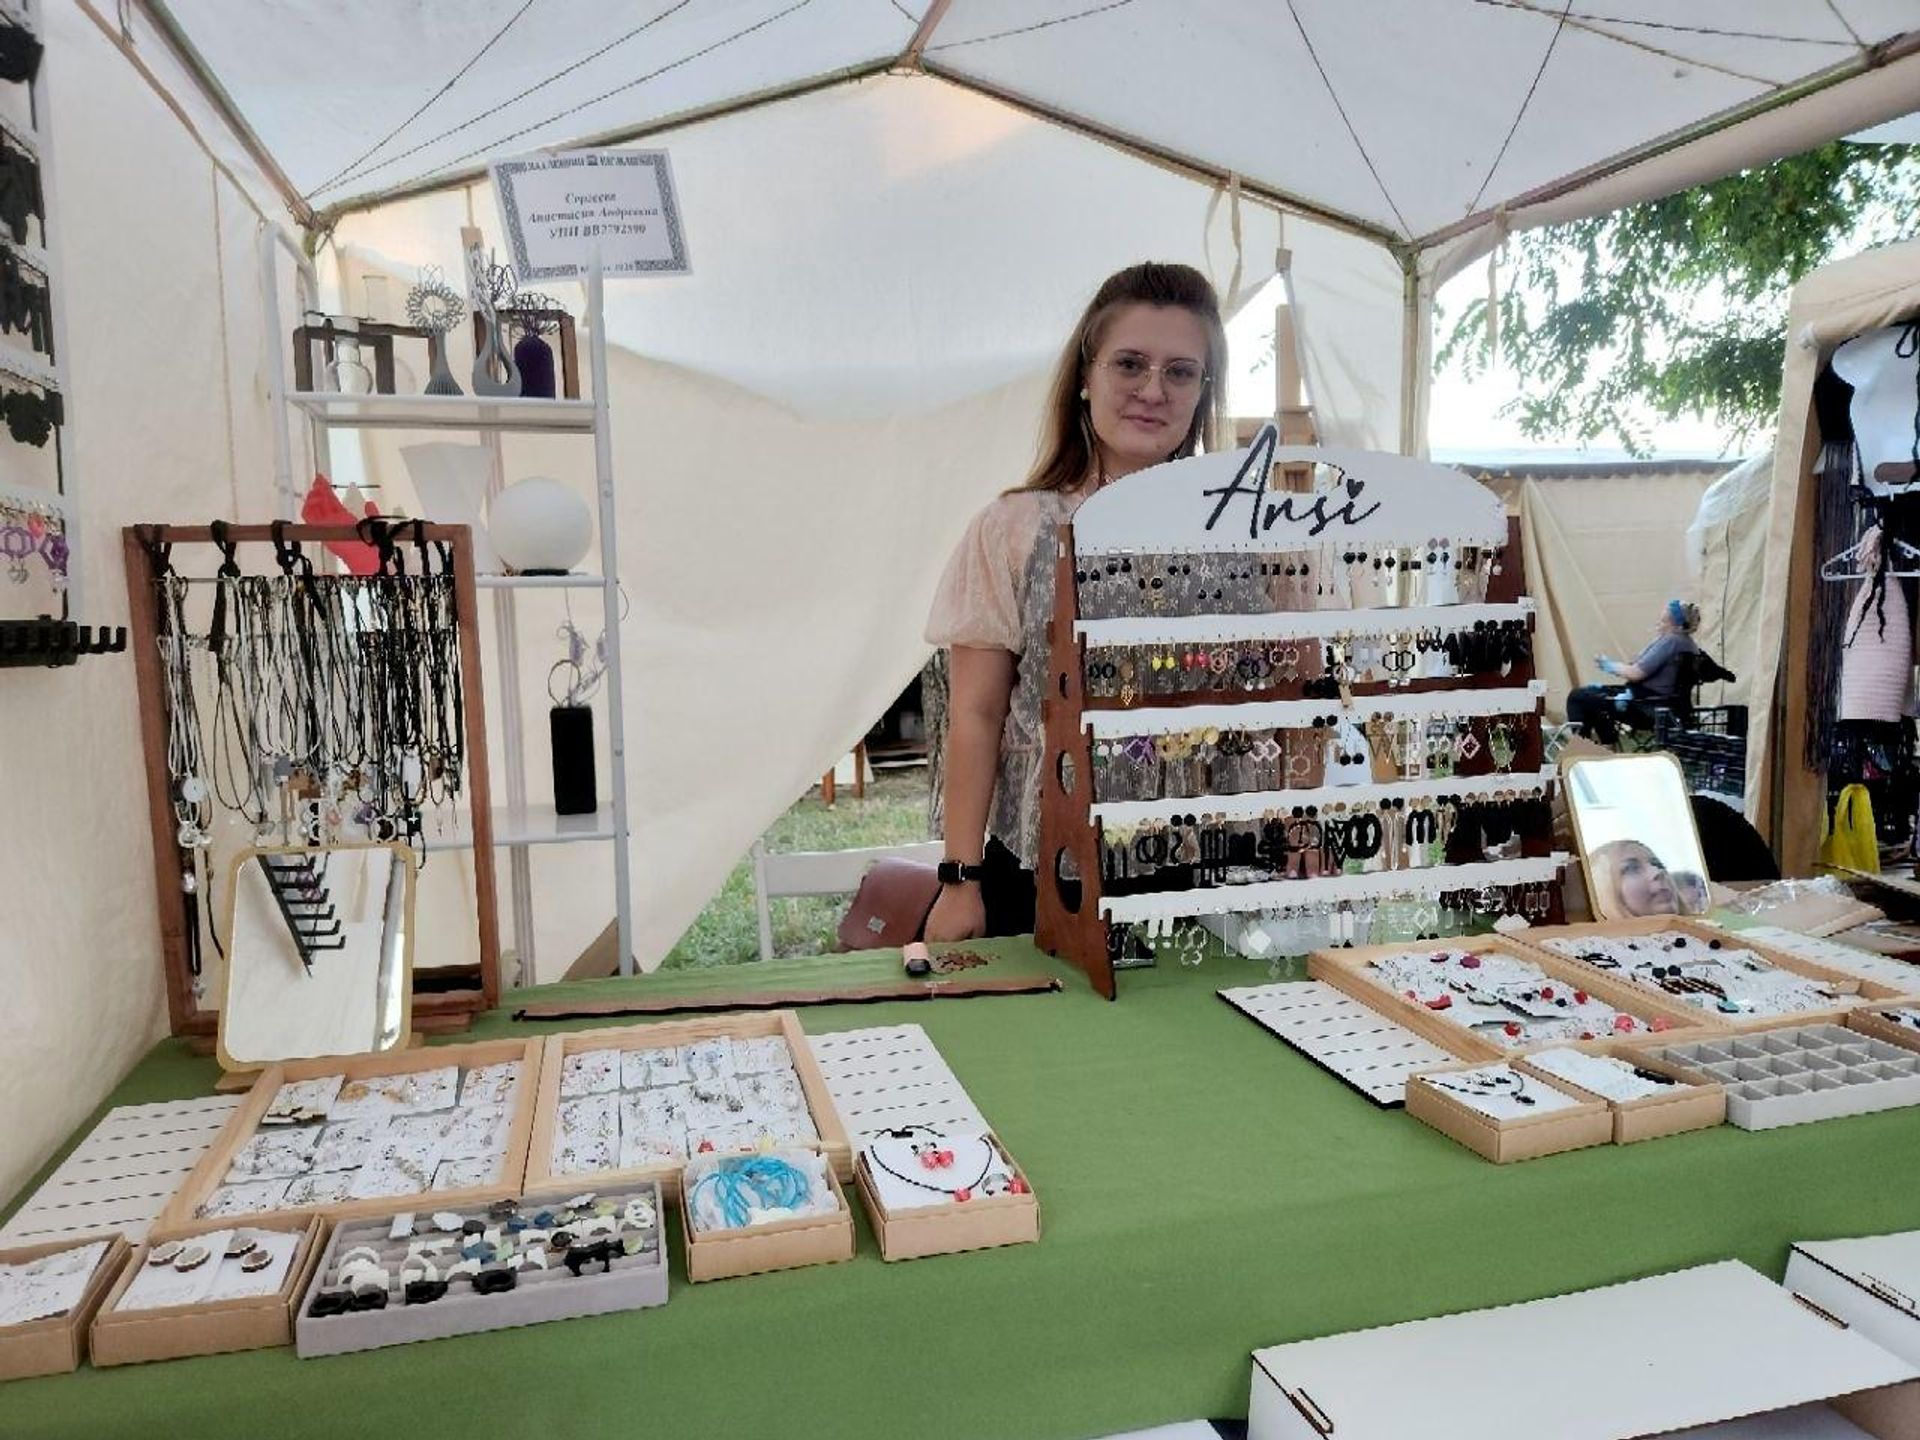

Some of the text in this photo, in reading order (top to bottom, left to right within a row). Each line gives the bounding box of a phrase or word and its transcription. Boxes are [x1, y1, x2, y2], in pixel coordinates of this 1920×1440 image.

[528, 208, 659, 223] Анастасия Андреевна
[1203, 425, 1381, 539] Ansi
